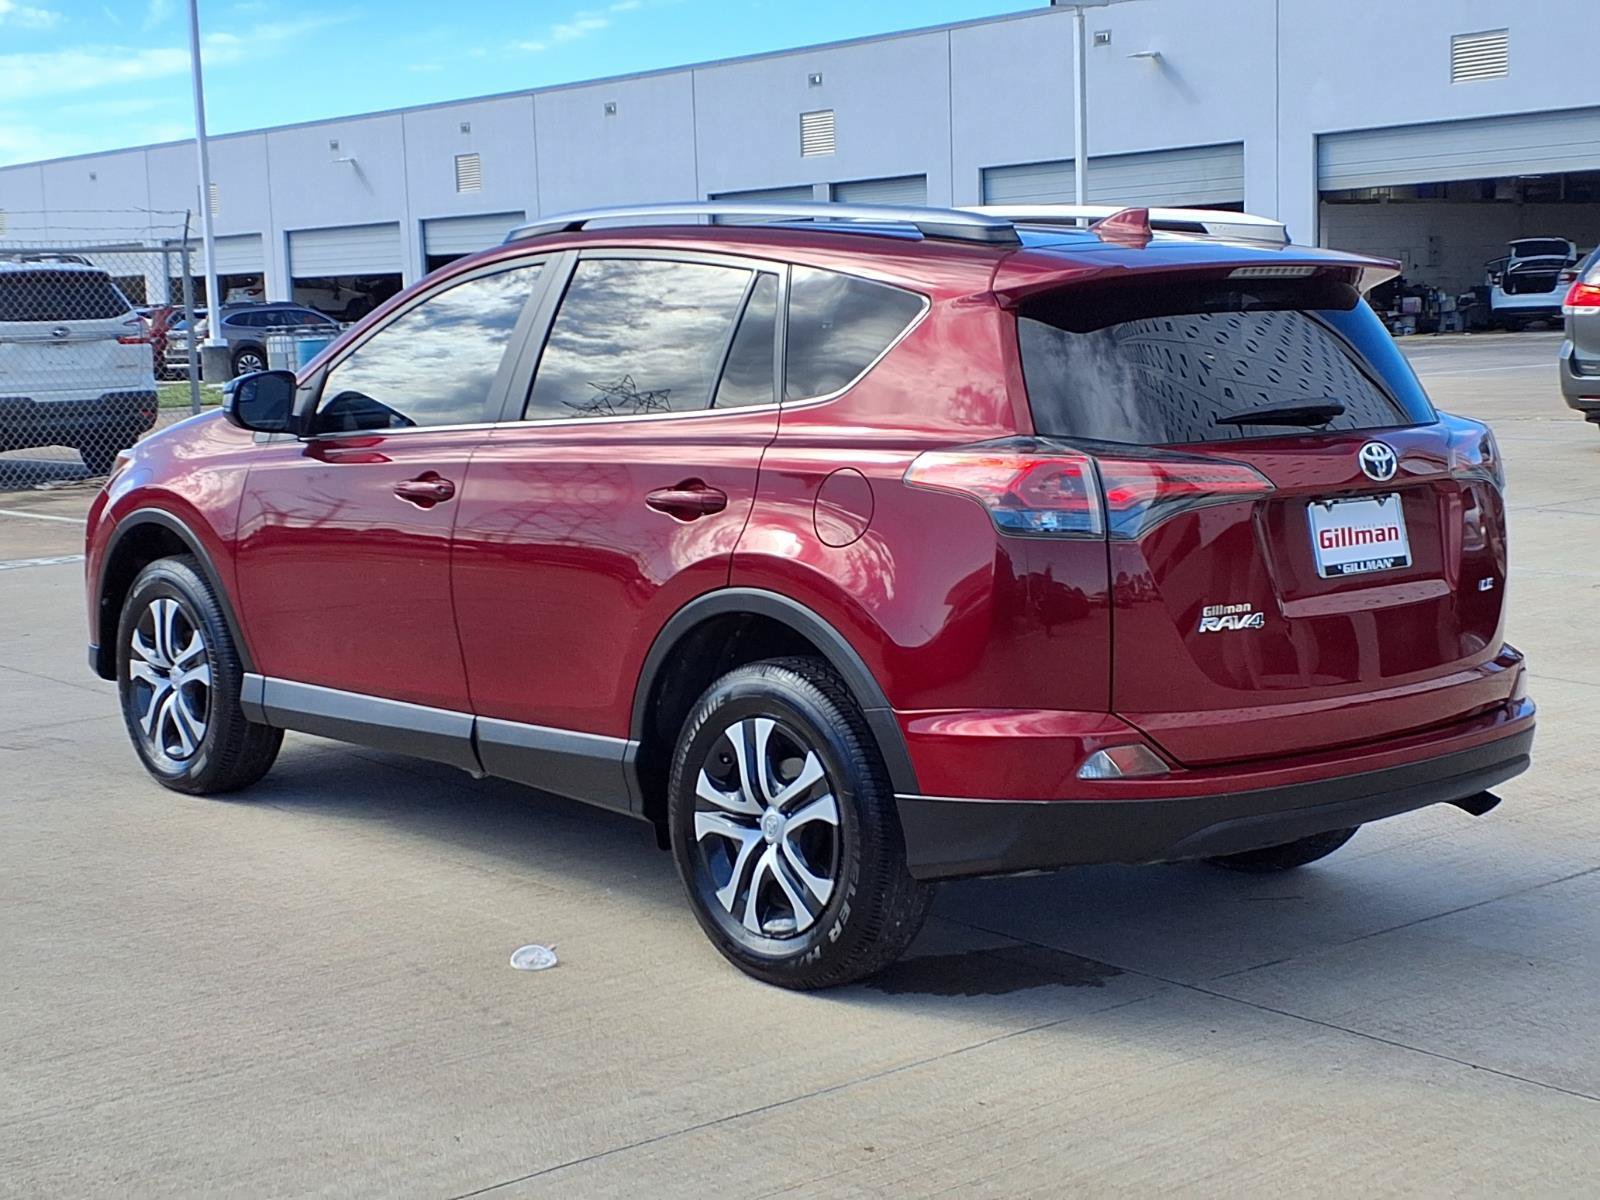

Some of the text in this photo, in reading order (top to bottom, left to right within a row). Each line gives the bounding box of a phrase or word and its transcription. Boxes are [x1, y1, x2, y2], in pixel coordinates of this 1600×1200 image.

[1319, 526, 1399, 549] Gillman
[1342, 558, 1393, 574] GILLMAN
[1479, 577, 1494, 591] LE
[1203, 603, 1251, 617] Gillman
[1199, 612, 1265, 633] RAV4
